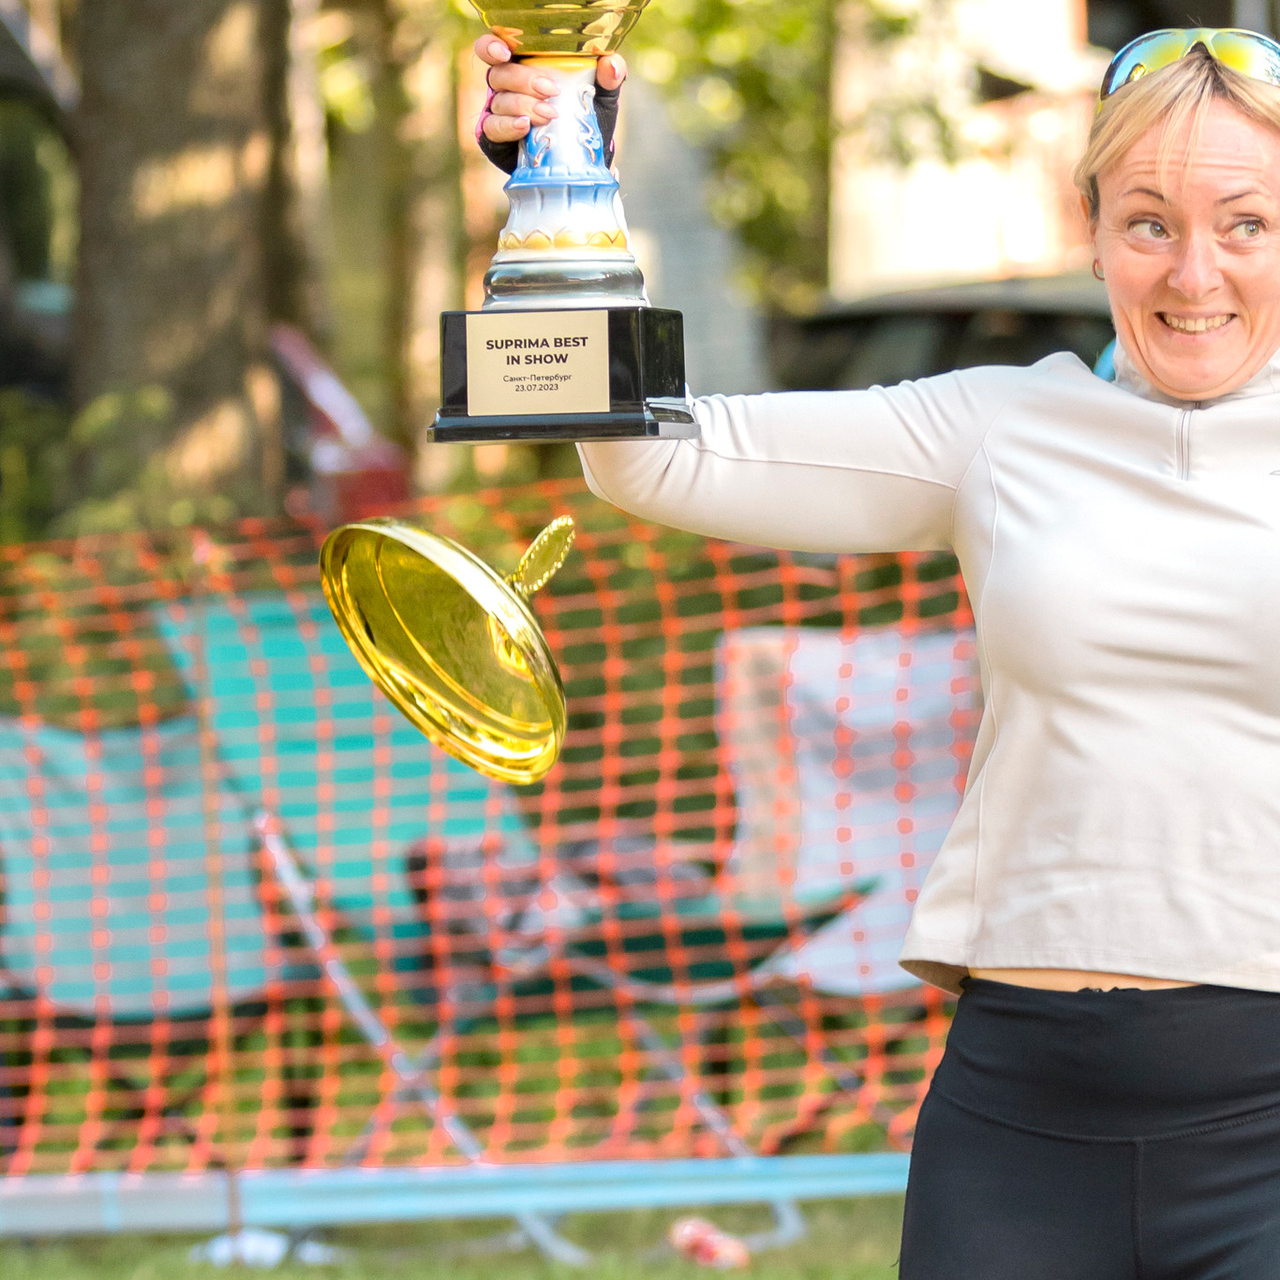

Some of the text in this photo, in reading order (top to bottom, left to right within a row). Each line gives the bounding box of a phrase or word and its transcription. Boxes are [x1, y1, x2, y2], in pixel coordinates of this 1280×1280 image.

[486, 337, 589, 350] SUPRIMA BEST
[506, 353, 568, 365] IN SHOW
[503, 373, 572, 383] Санкт-Петербург
[515, 384, 559, 392] 23.07.2023
